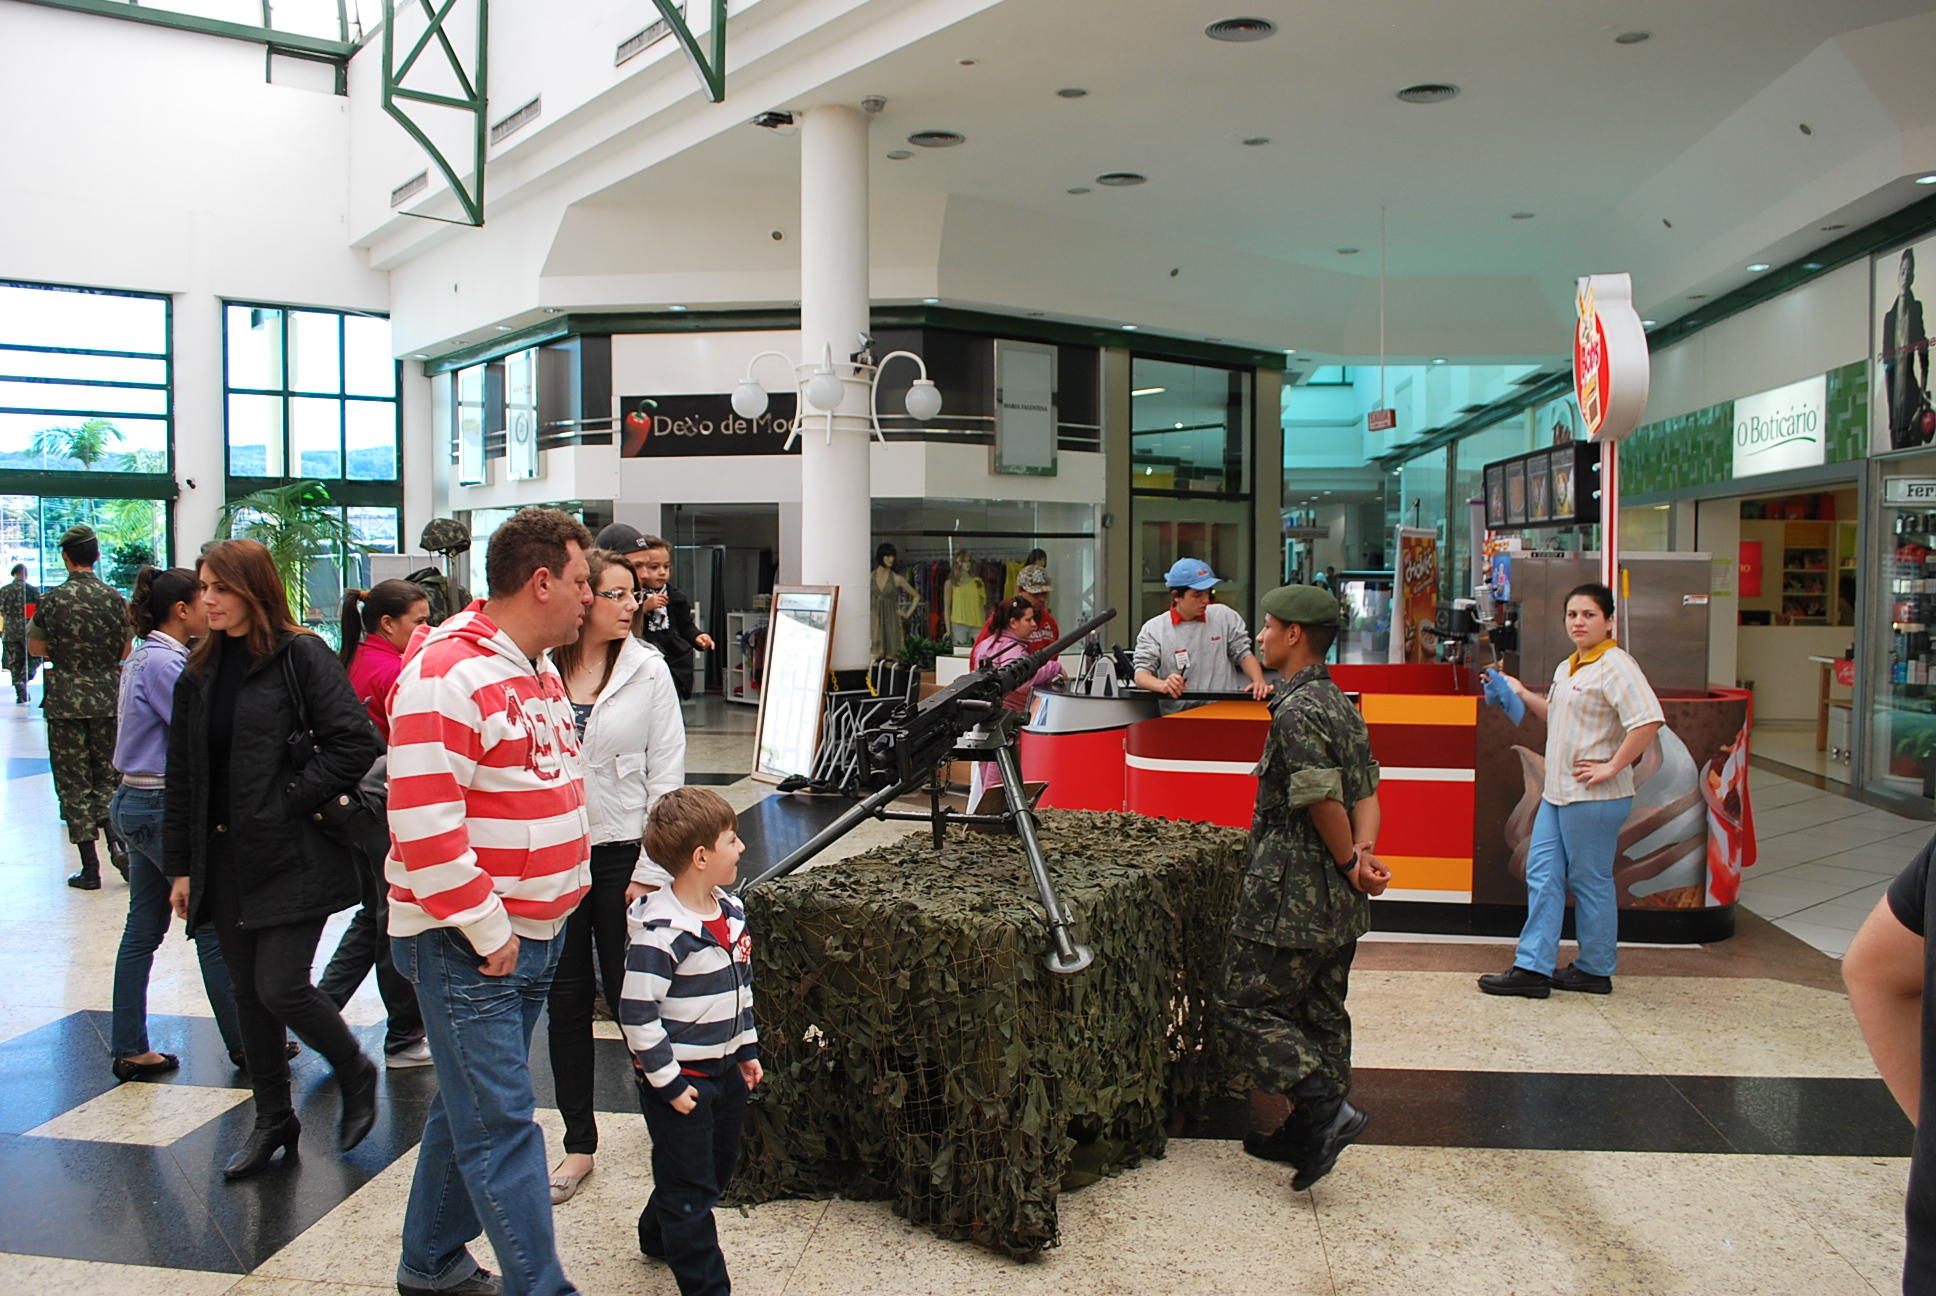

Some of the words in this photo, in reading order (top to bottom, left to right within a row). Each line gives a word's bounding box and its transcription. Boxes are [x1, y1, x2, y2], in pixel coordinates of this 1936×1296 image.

[719, 413, 747, 435] de
[1737, 421, 1748, 447] O
[1750, 403, 1818, 445] Boticário
[1907, 483, 1936, 497] Fer
